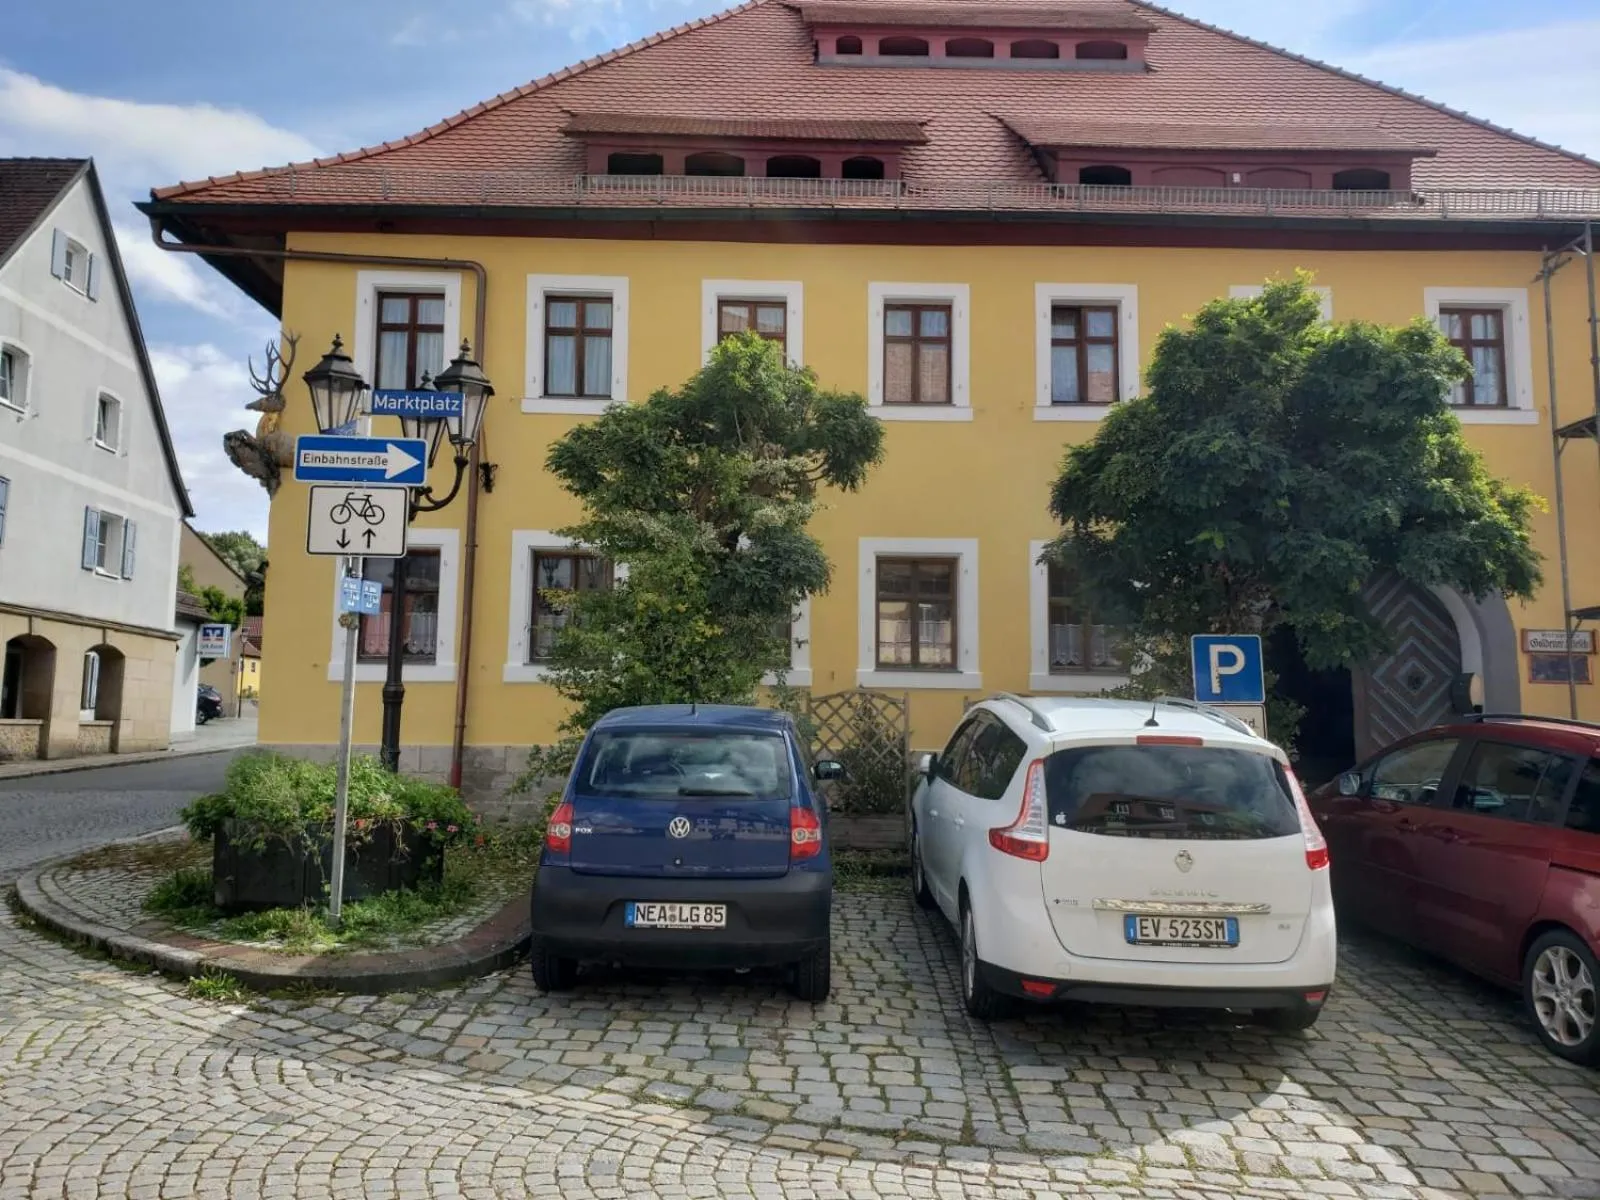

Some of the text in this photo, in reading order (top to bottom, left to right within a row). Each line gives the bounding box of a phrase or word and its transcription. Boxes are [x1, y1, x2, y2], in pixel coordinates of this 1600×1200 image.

[373, 394, 460, 413] Marktplatz
[303, 453, 389, 467] Einbahnstraße
[1209, 644, 1246, 694] P
[635, 905, 724, 923] NEA LG 85
[1139, 918, 1226, 940] EV 523SM
